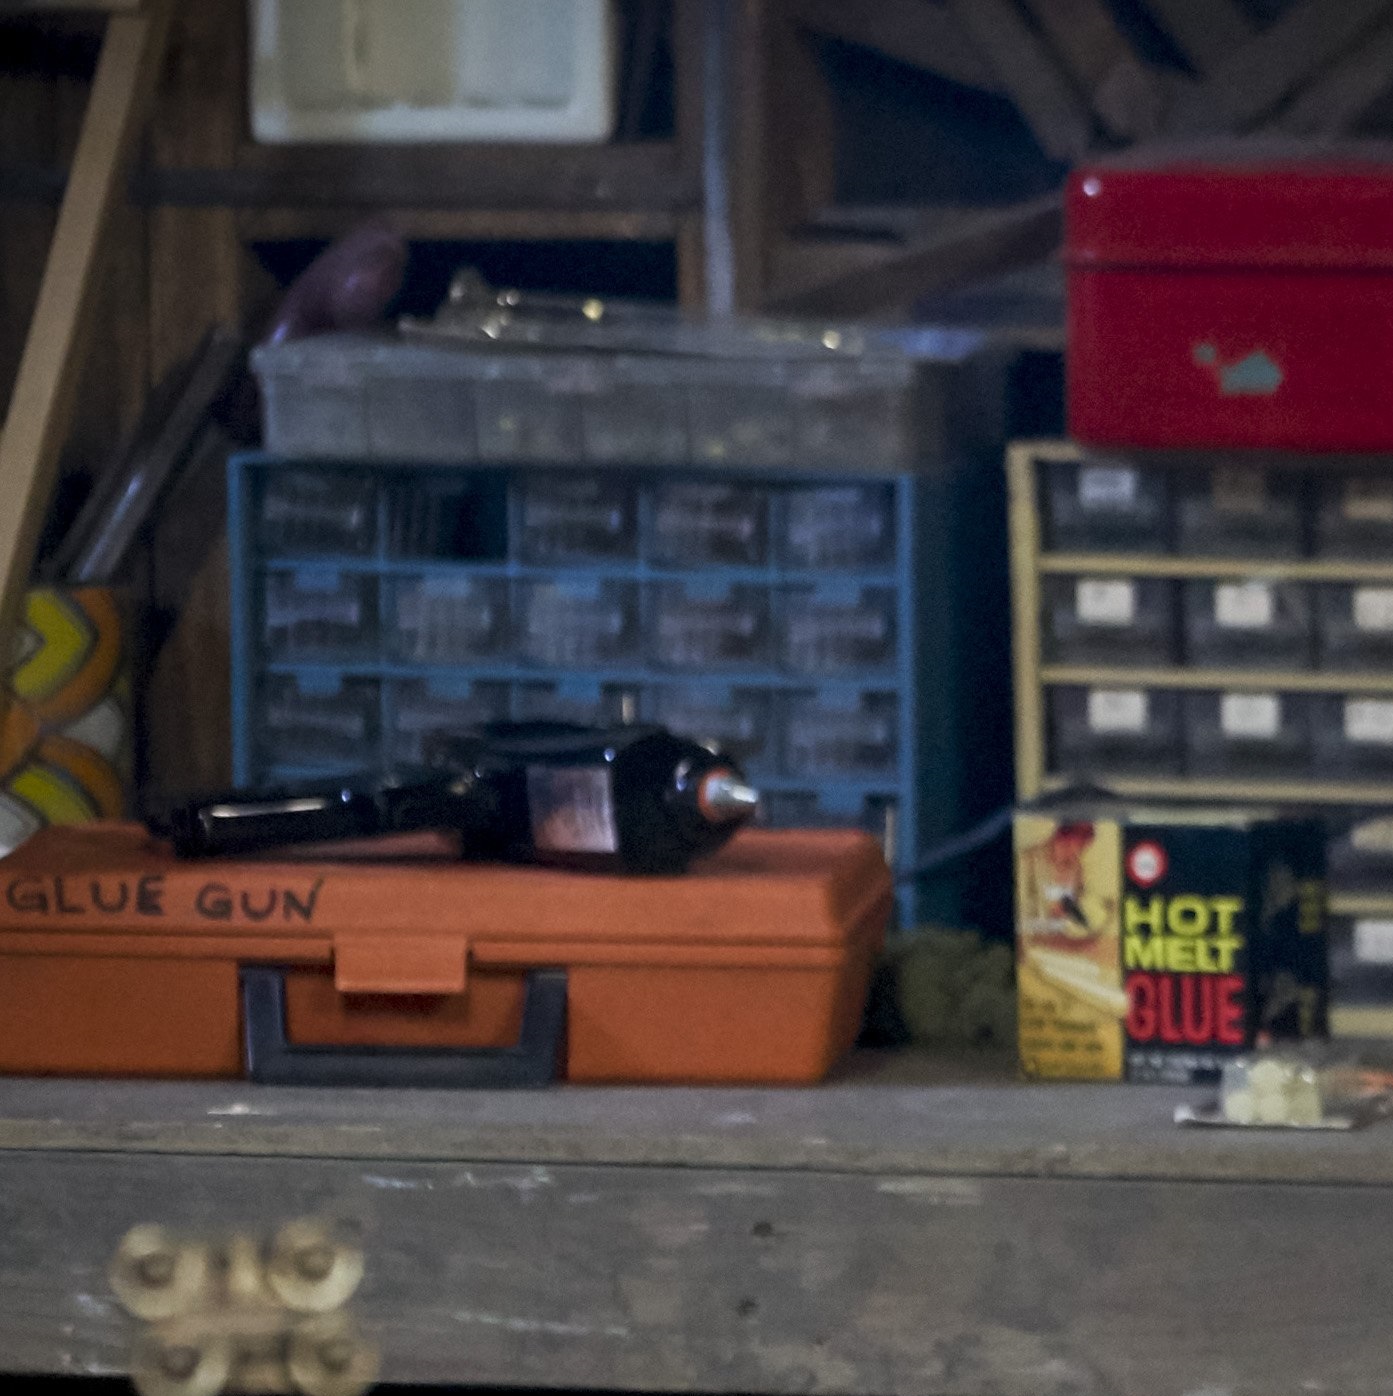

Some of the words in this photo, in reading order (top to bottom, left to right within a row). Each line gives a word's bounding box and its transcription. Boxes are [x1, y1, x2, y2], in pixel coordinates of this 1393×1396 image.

[5, 874, 165, 916] GLUE
[194, 873, 325, 922] GUN
[1123, 896, 1243, 938] HOT
[1123, 936, 1245, 974] MELT
[1124, 973, 1246, 1044] GLUE
